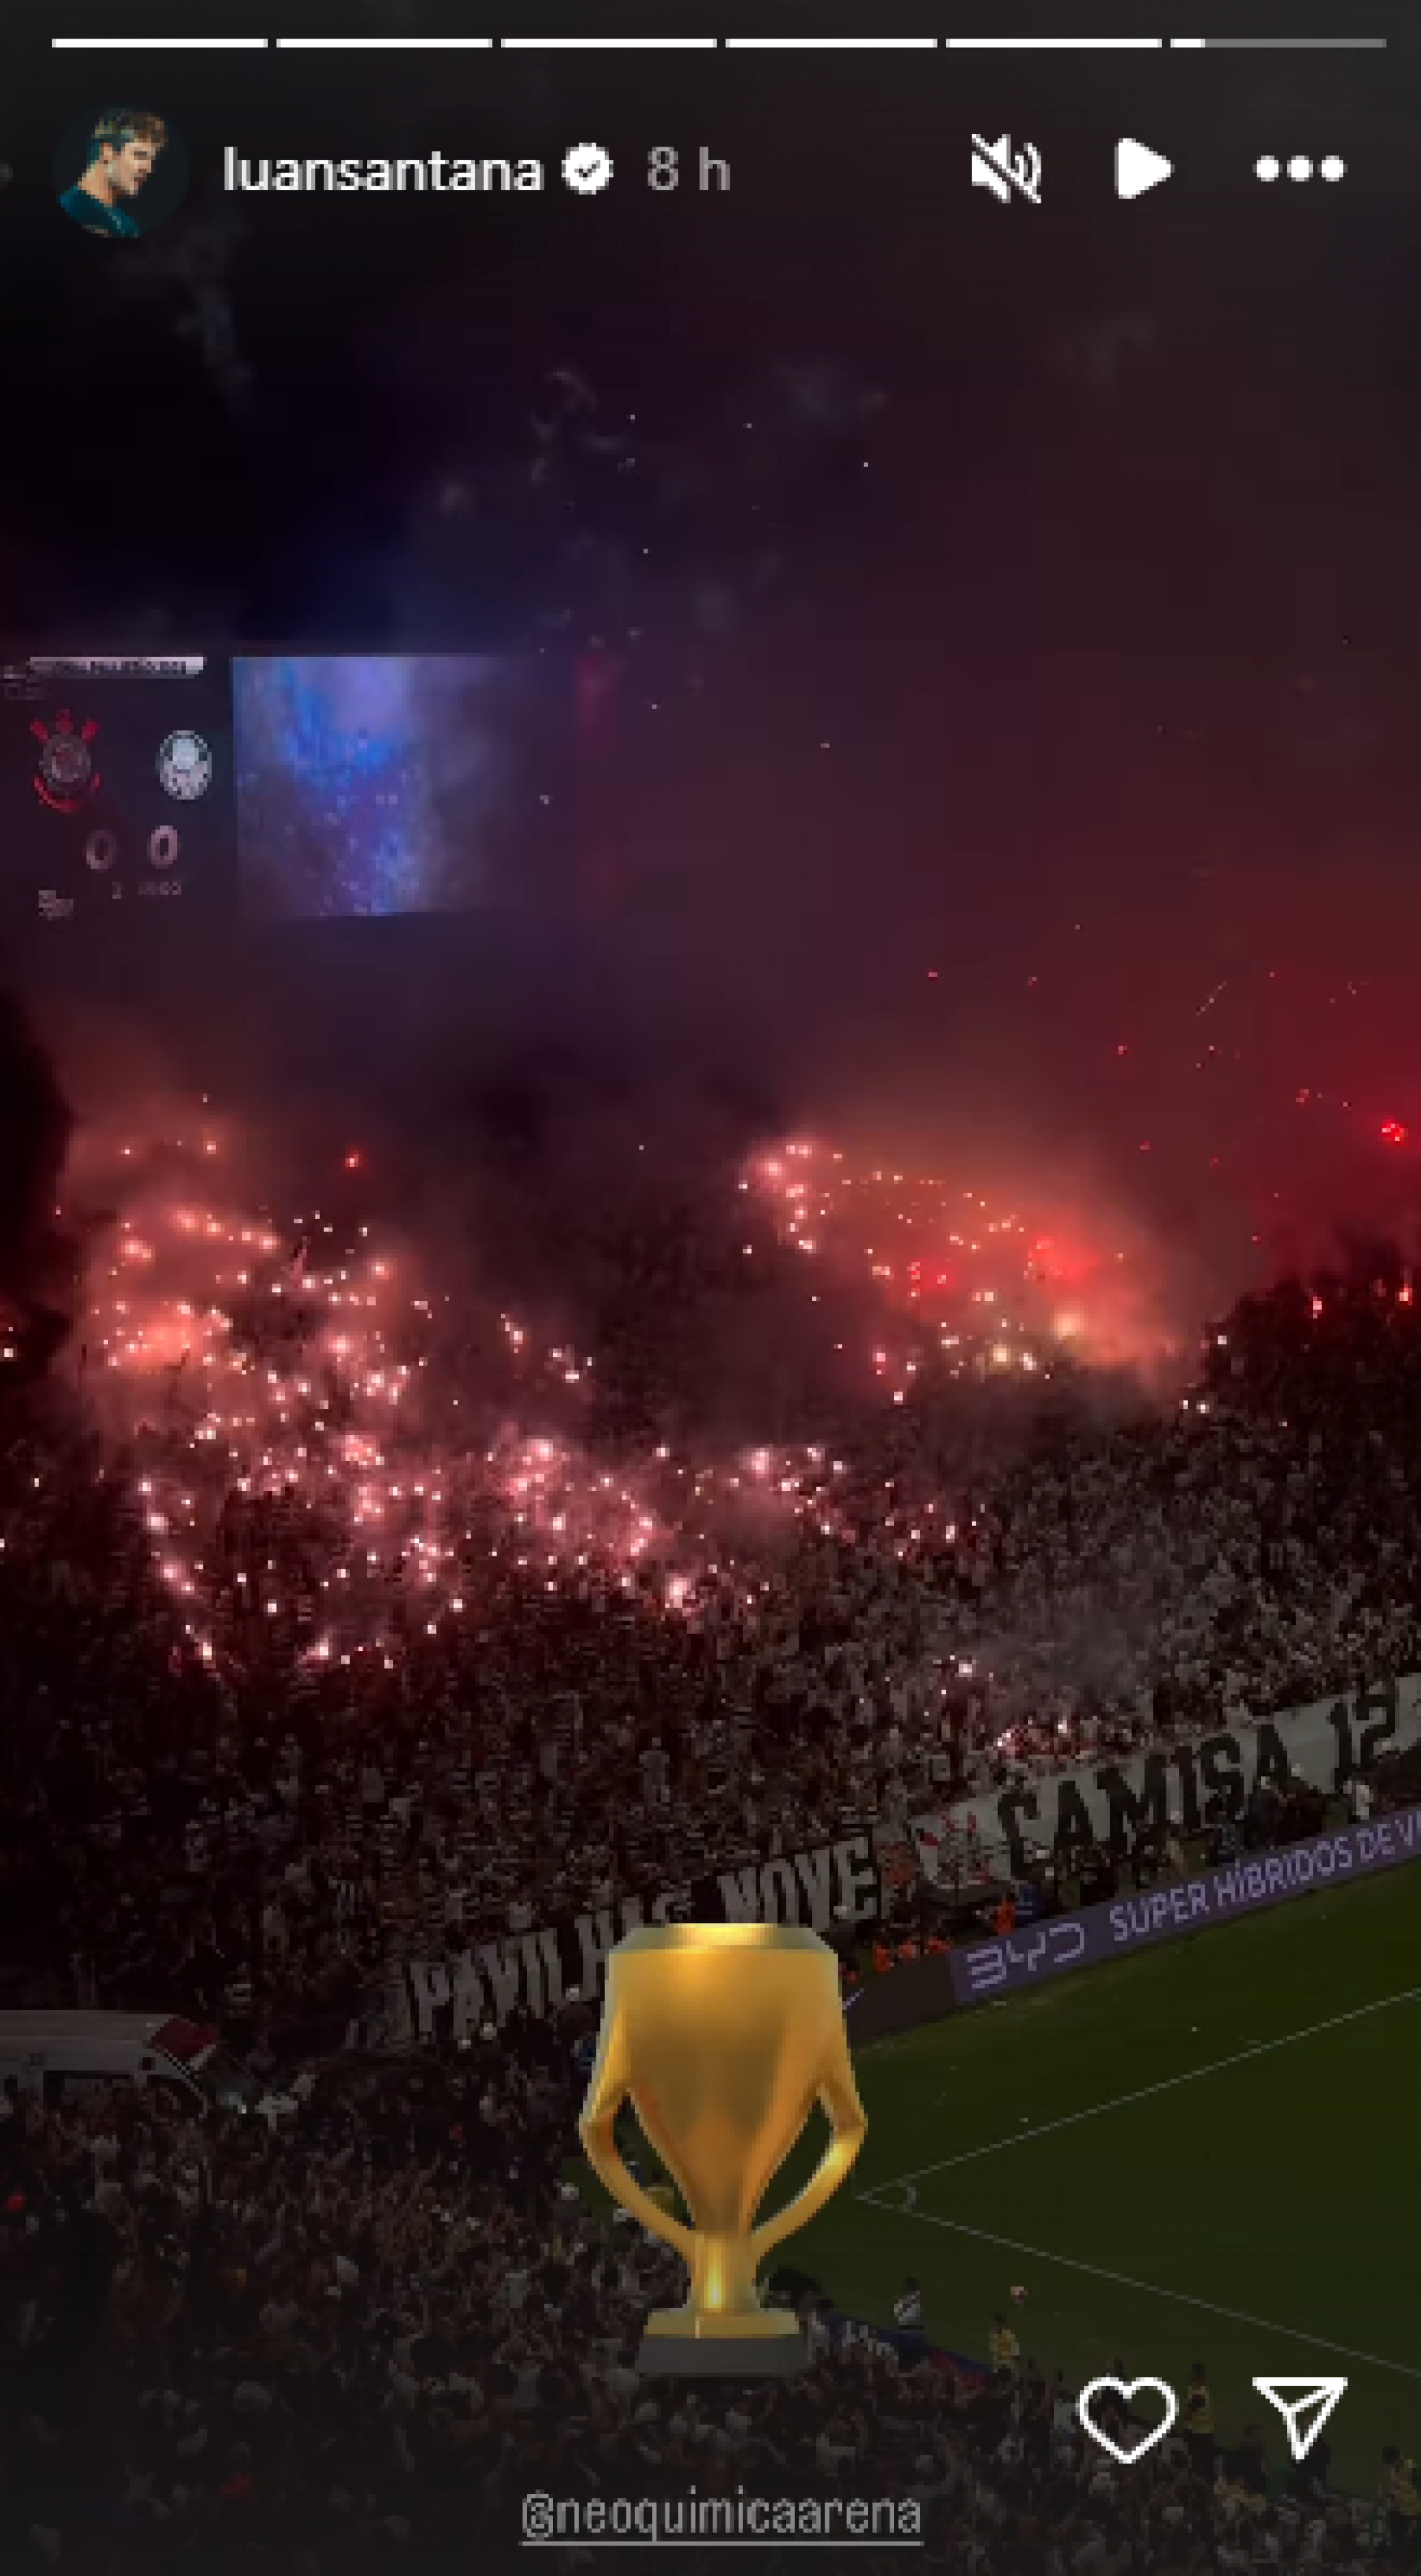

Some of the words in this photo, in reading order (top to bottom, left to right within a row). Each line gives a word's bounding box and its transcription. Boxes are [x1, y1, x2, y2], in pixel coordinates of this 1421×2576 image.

[150, 825, 179, 868] 0
[997, 1724, 1290, 1878] CAMISA
[967, 1923, 1085, 1989] BYD
[1109, 1883, 1210, 1942] SUPER
[1215, 1835, 1354, 1908] HÍBRIDOS
[1355, 1825, 1396, 1862] DE
